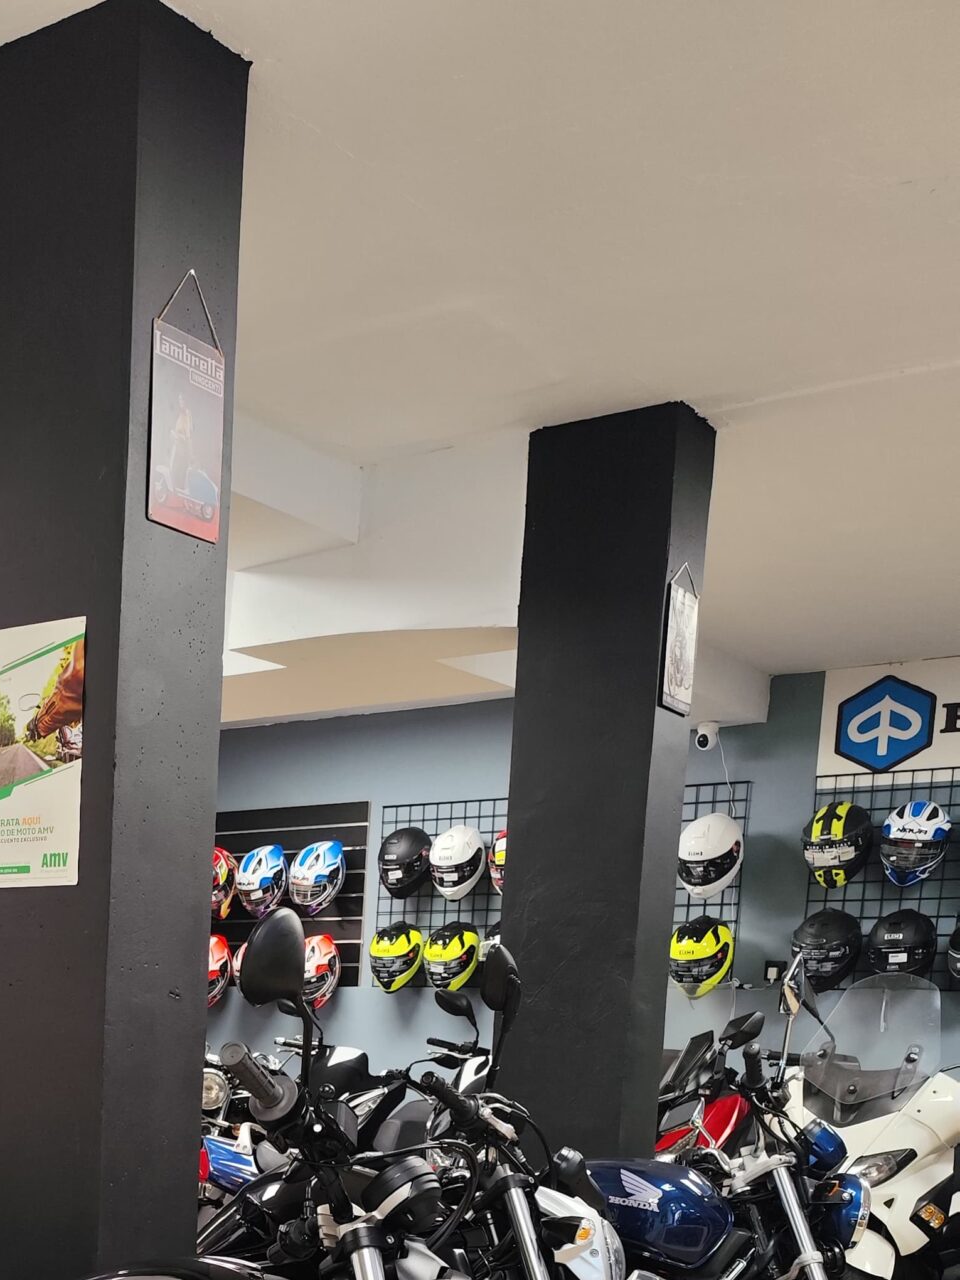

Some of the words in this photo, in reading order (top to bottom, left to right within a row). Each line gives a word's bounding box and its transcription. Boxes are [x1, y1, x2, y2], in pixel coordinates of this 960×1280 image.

[6, 828, 16, 837] DE
[17, 827, 37, 836] MOTO
[37, 825, 55, 835] AMV
[20, 835, 48, 843] EXCLUSIVO
[608, 1195, 660, 1212] HONDA
